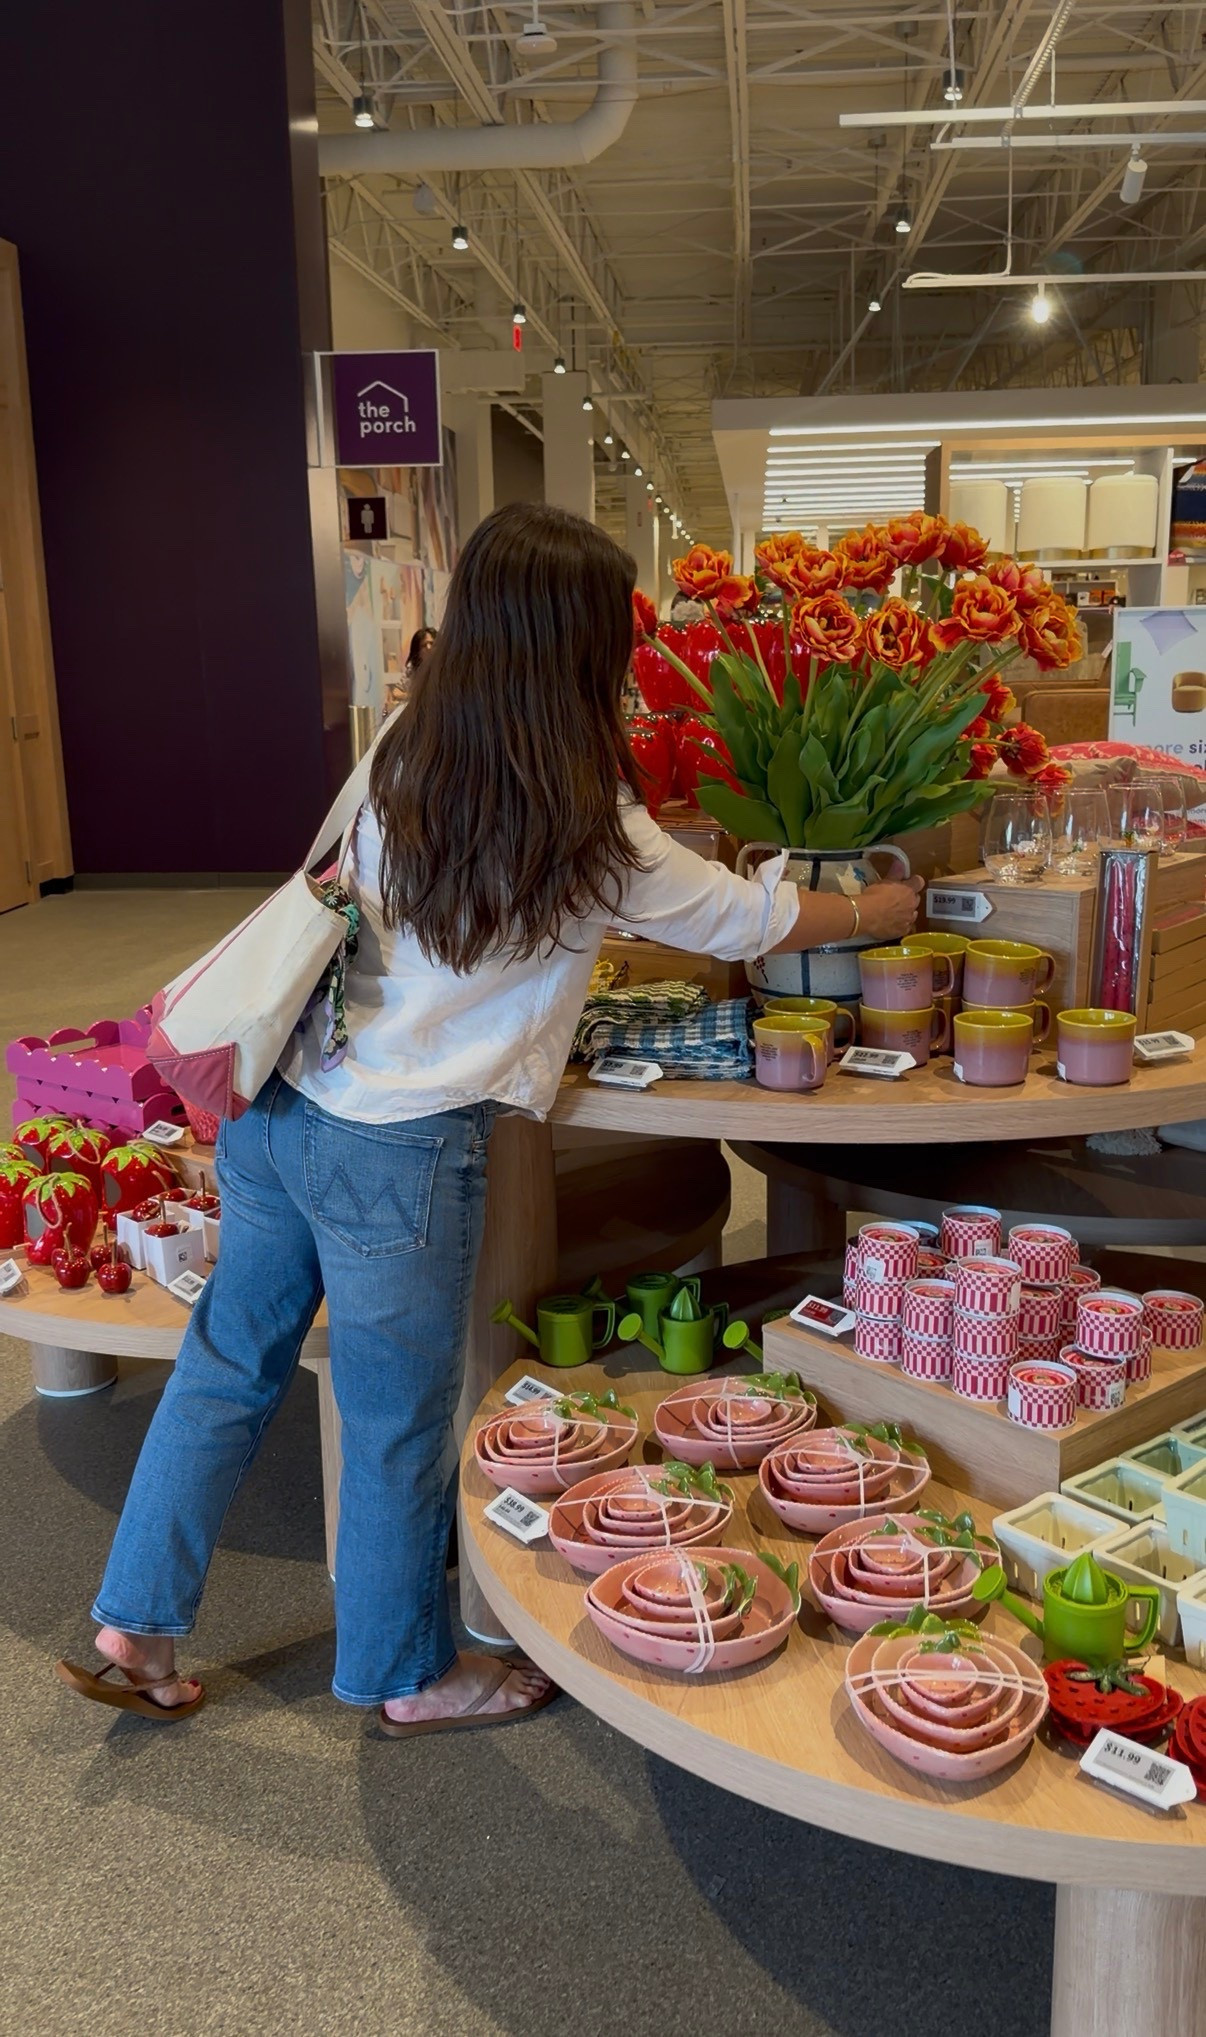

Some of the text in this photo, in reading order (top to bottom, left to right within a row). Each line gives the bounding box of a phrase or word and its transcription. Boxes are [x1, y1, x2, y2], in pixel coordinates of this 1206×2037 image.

[358, 401, 390, 418] the
[360, 415, 416, 438] porch
[1141, 739, 1206, 755] ore si
[1104, 1742, 1141, 1765] $11.99
